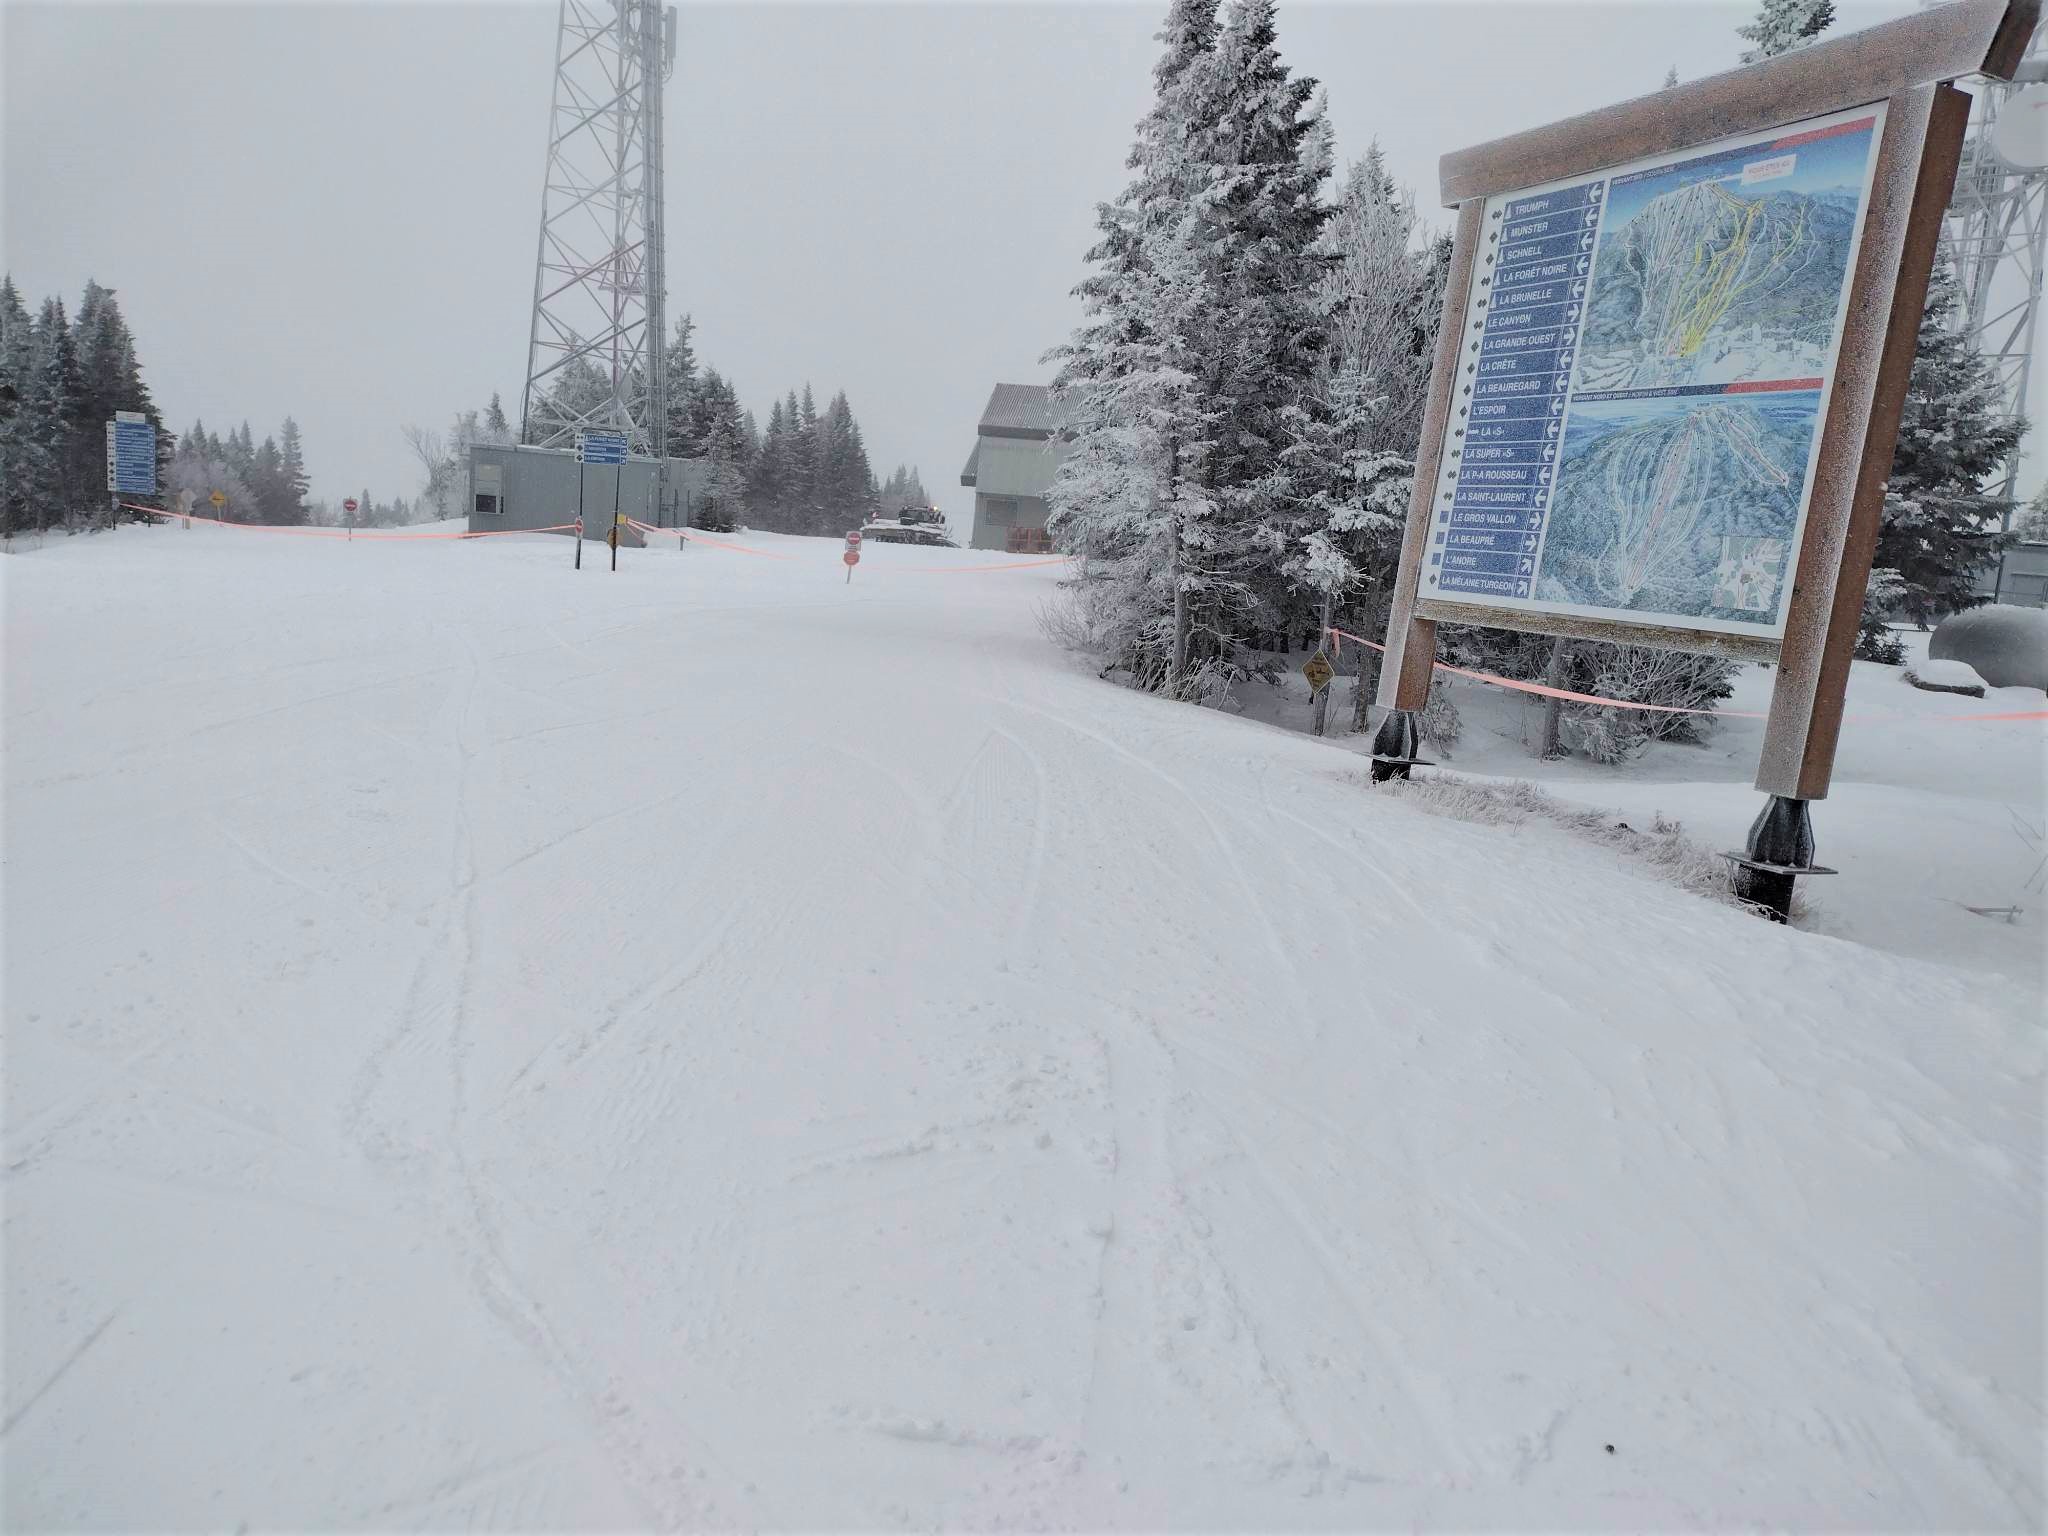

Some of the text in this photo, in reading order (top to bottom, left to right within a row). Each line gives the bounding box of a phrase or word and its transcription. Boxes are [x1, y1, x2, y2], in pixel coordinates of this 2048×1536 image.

[1516, 200, 1549, 215] TRIUMPH
[1507, 246, 1542, 260] SCHNELL
[1504, 264, 1568, 282] LA FORÊT NOIRE
[1500, 288, 1552, 304] LA BRUNELLE
[1488, 313, 1532, 328] LE CANYON
[1484, 333, 1556, 350] LA GRANDE OUEST
[1480, 358, 1516, 372] LA CRÊTE
[1476, 380, 1540, 394] LA BEAUREGARD
[1472, 405, 1506, 416] L'ESPOIR
[1481, 427, 1490, 436] LA
[1465, 450, 1474, 458] LA
[1476, 449, 1500, 458] SUPER
[1460, 470, 1527, 480] LA P-A ROUSSEAU
[1457, 492, 1526, 502] LA SAINT-LAURENT
[1454, 513, 1516, 524] LE GROS VALLON
[1450, 534, 1458, 544] LA
[1442, 576, 1514, 592] LA MÉLANIE TURGEON
